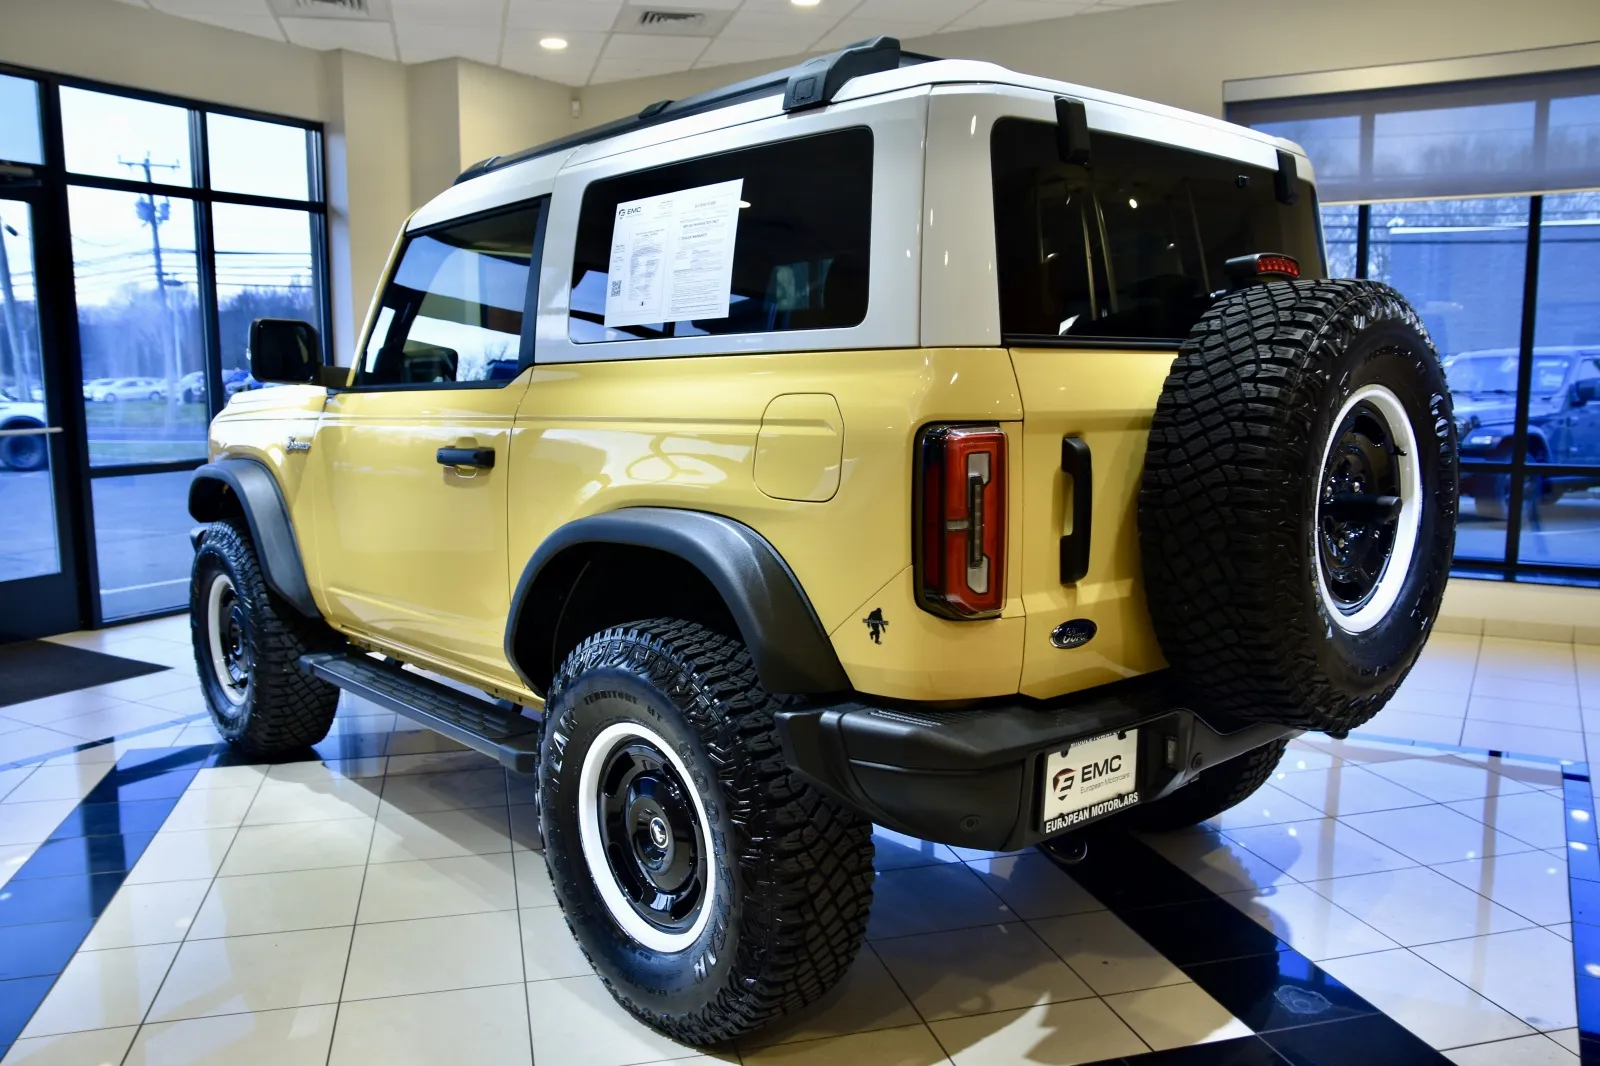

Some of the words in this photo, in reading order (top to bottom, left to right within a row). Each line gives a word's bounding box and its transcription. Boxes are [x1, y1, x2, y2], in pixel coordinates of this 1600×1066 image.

[627, 206, 642, 215] EMC
[1062, 626, 1089, 644] Ford
[1081, 754, 1122, 783] EMC
[1080, 780, 1105, 794] European
[1105, 772, 1130, 786] Motorcars
[1045, 807, 1090, 834] EUROPEAN
[1091, 792, 1139, 817] MOTORCARS
